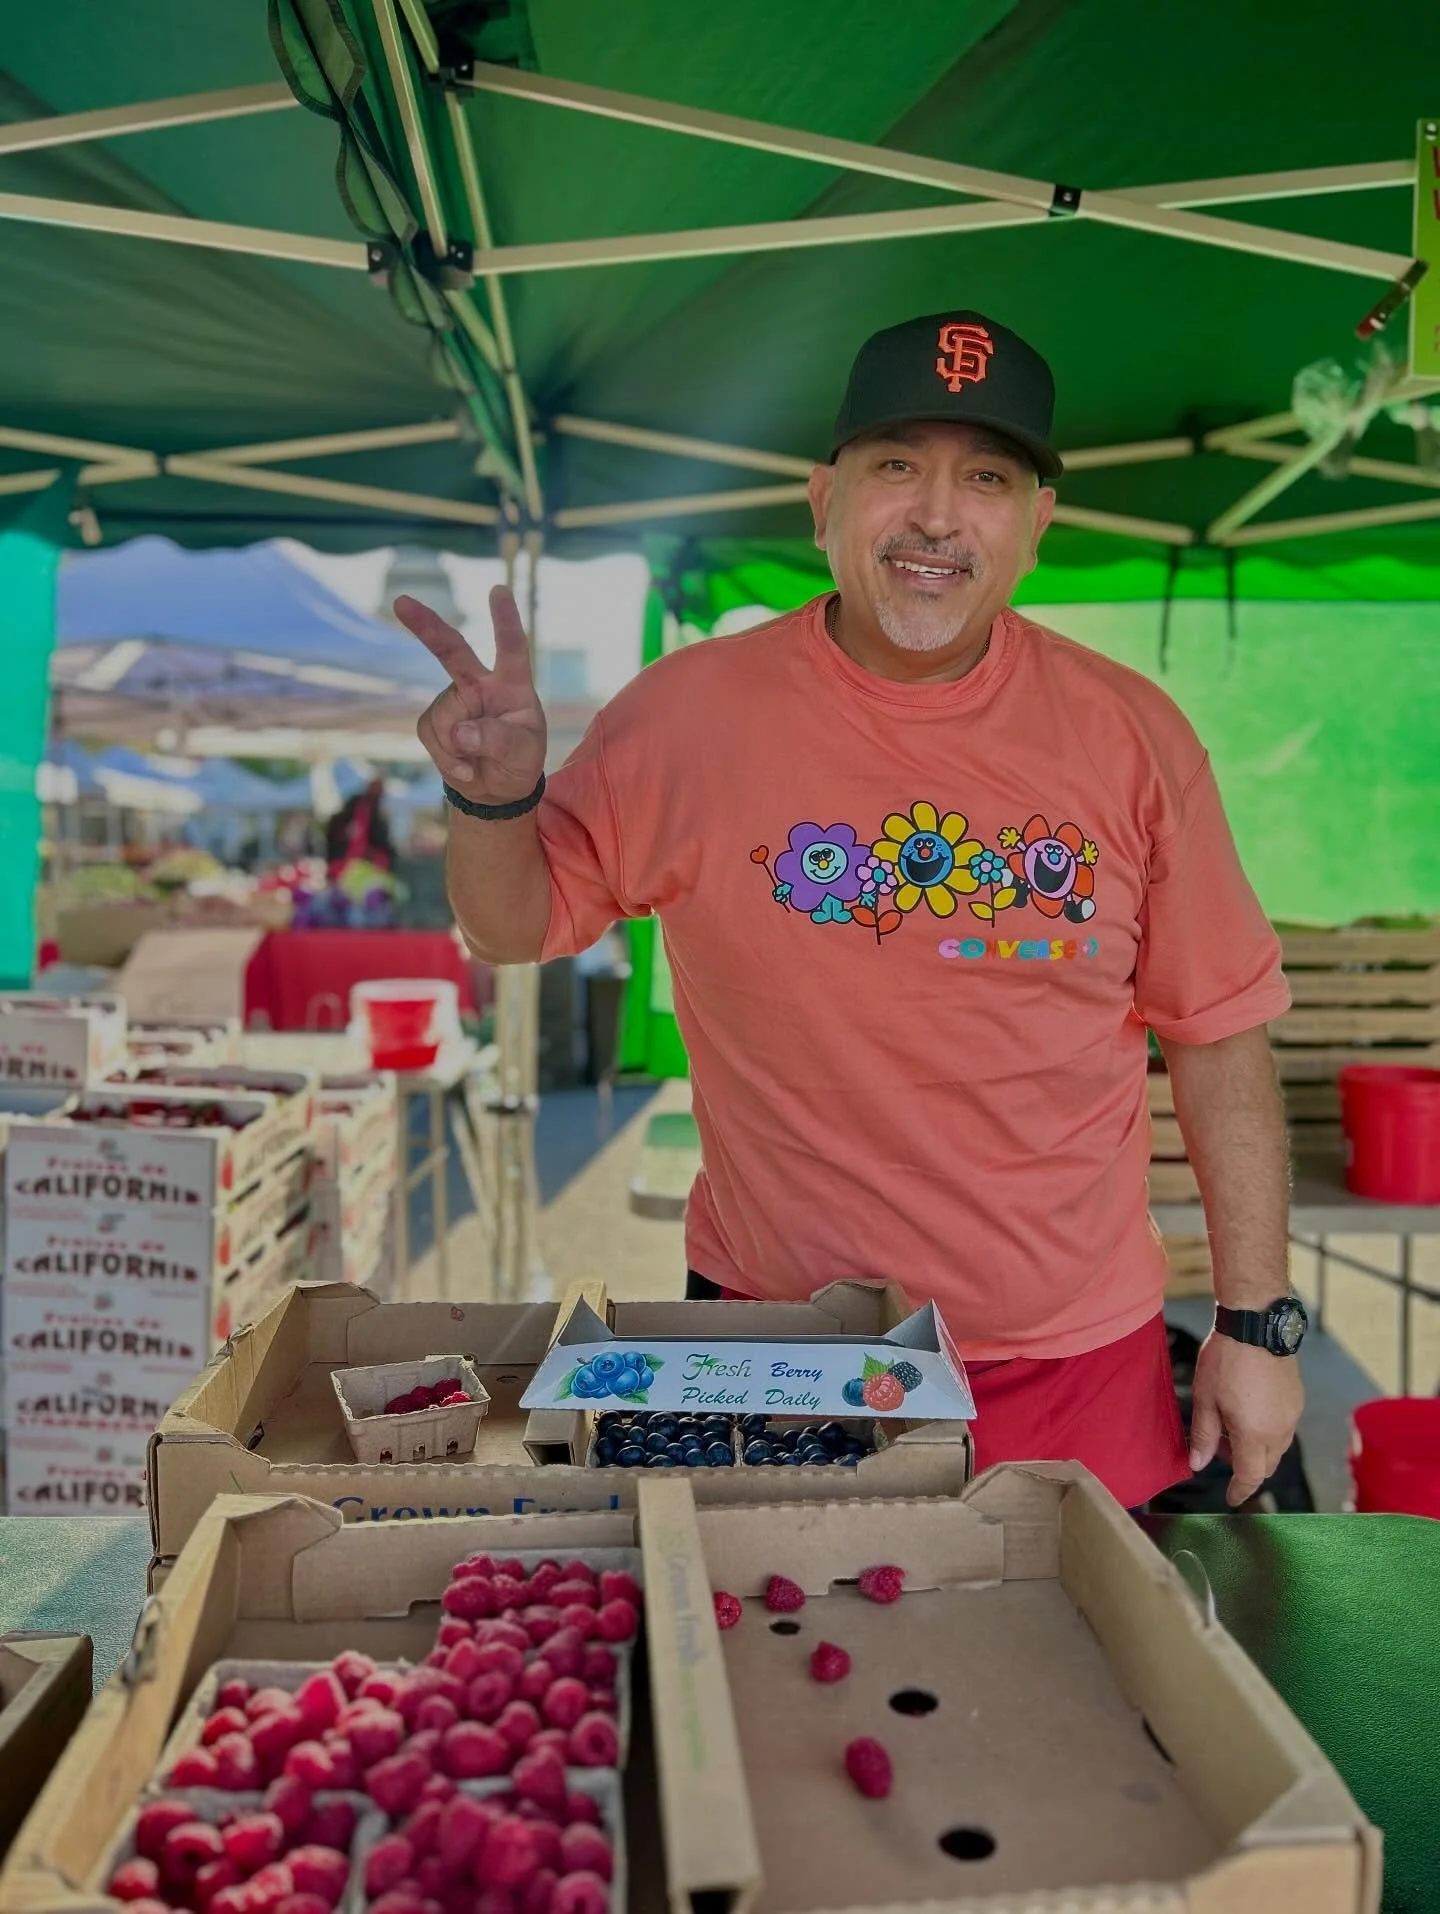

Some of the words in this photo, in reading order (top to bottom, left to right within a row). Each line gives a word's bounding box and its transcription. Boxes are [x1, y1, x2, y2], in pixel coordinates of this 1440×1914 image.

[937, 323, 993, 392] SF
[682, 1353, 751, 1380] Fresh
[771, 1361, 823, 1382] Berry
[16, 1391, 171, 1418] CALIFORN
[681, 1386, 749, 1404] Picked
[765, 1388, 821, 1410] Daily
